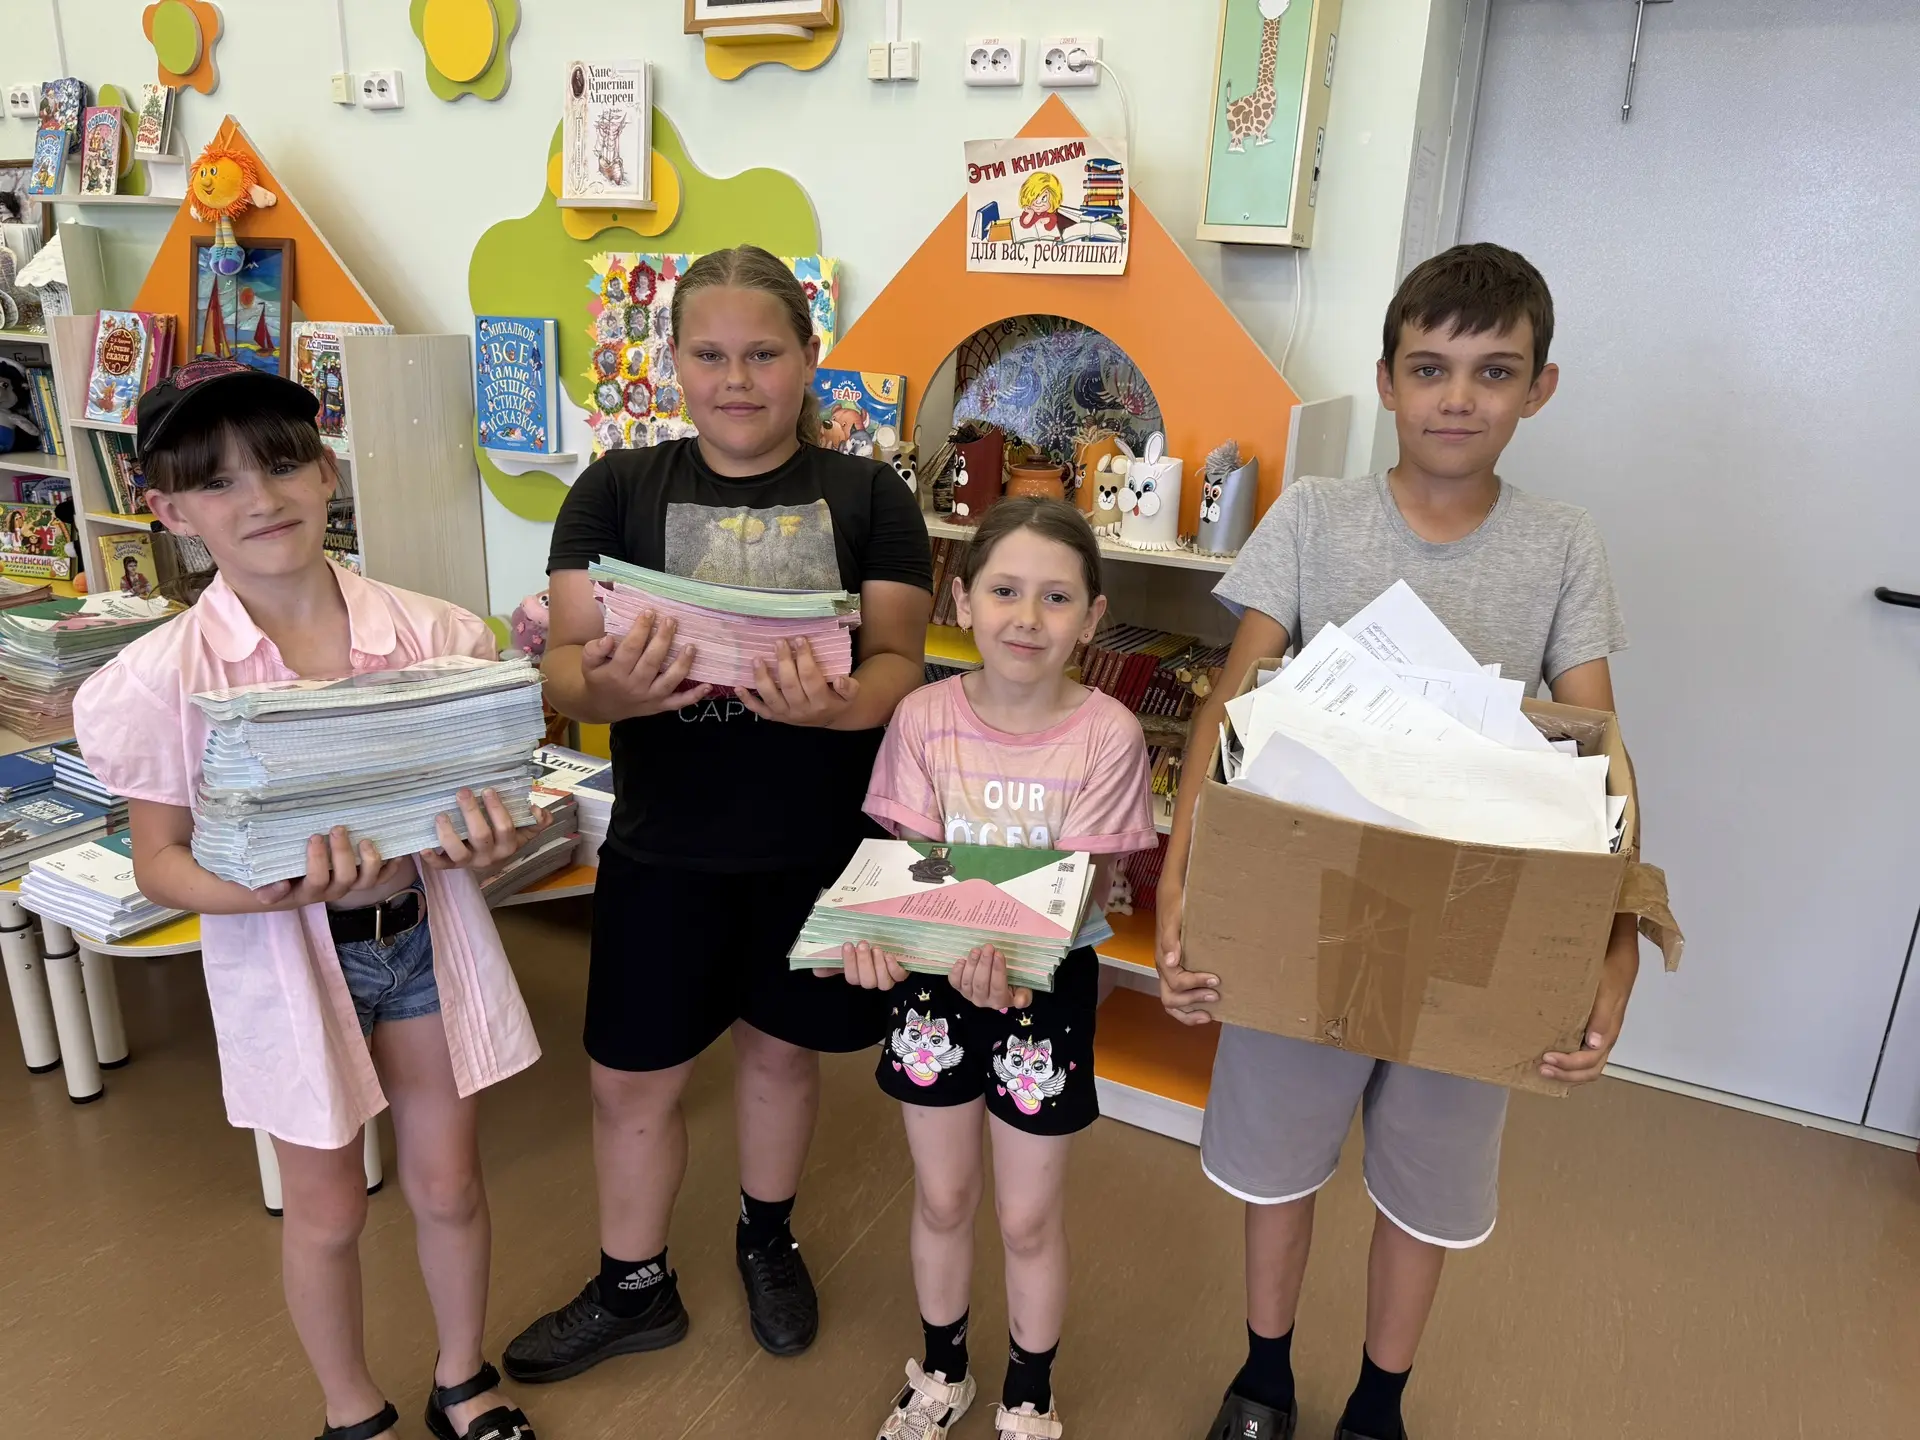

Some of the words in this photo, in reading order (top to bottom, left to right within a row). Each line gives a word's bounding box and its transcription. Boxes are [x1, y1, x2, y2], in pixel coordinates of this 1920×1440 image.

[588, 65, 611, 78] Ханс
[588, 78, 634, 91] Кристиан
[588, 92, 634, 105] Андерсен
[970, 242, 997, 263] для
[1001, 240, 1029, 266] вас,
[1032, 239, 1123, 268] ребятишки!
[313, 331, 336, 340] Сказки
[306, 340, 340, 351] А.С.Пушкин
[490, 340, 529, 367] ВСЕ
[489, 366, 529, 383] самые
[832, 386, 861, 401] ТЕАТР
[984, 780, 1045, 812] OUR
[52, 812, 84, 824] 8
[617, 1272, 665, 1290] adidas
